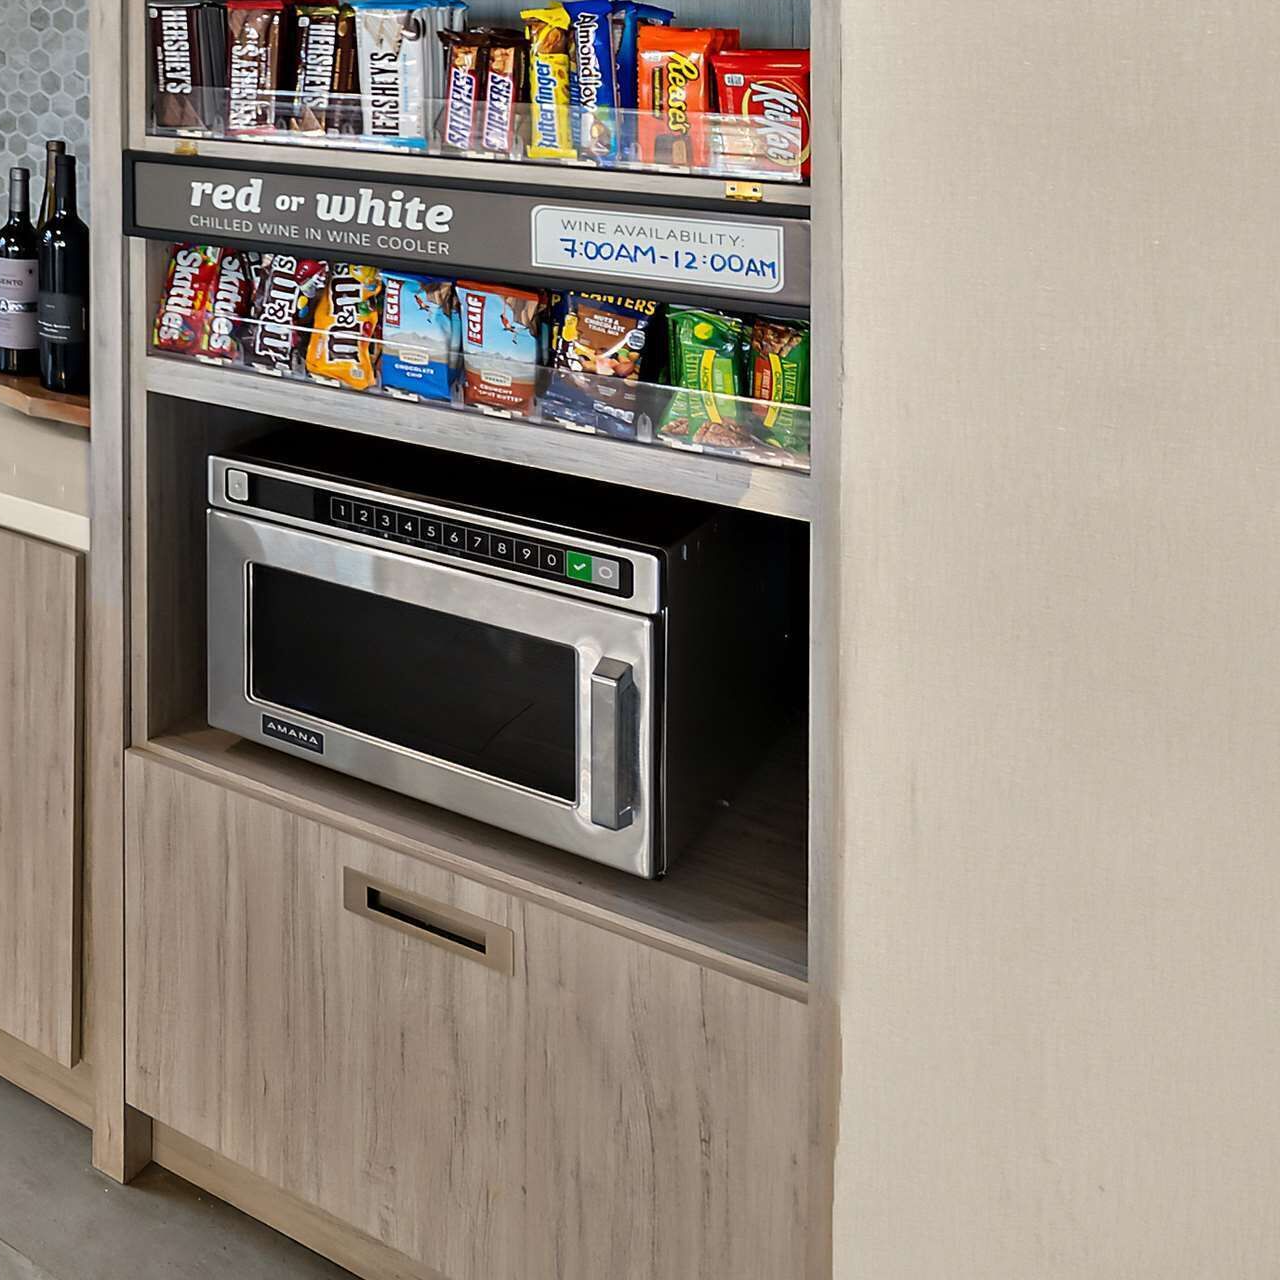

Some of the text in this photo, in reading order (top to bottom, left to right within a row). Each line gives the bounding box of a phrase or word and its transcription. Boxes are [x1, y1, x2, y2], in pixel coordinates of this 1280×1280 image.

[161, 9, 192, 94] HERSHEY'S
[667, 53, 700, 135] Reese's
[190, 178, 454, 234] red or white
[561, 219, 746, 248] WINE AVAILABILITY:
[189, 214, 450, 256] CHILLED WINE IN WINE COOLER
[159, 250, 203, 340] Skittles
[359, 510, 369, 522] 2
[381, 514, 390, 527] 3
[404, 521, 413, 532] 4
[427, 526, 436, 538] 5
[449, 531, 459, 543] 6
[473, 536, 482, 548] 7
[497, 542, 507, 554] 8
[521, 548, 531, 559] 9
[546, 554, 557, 566] 0
[266, 720, 320, 746] AMANA
